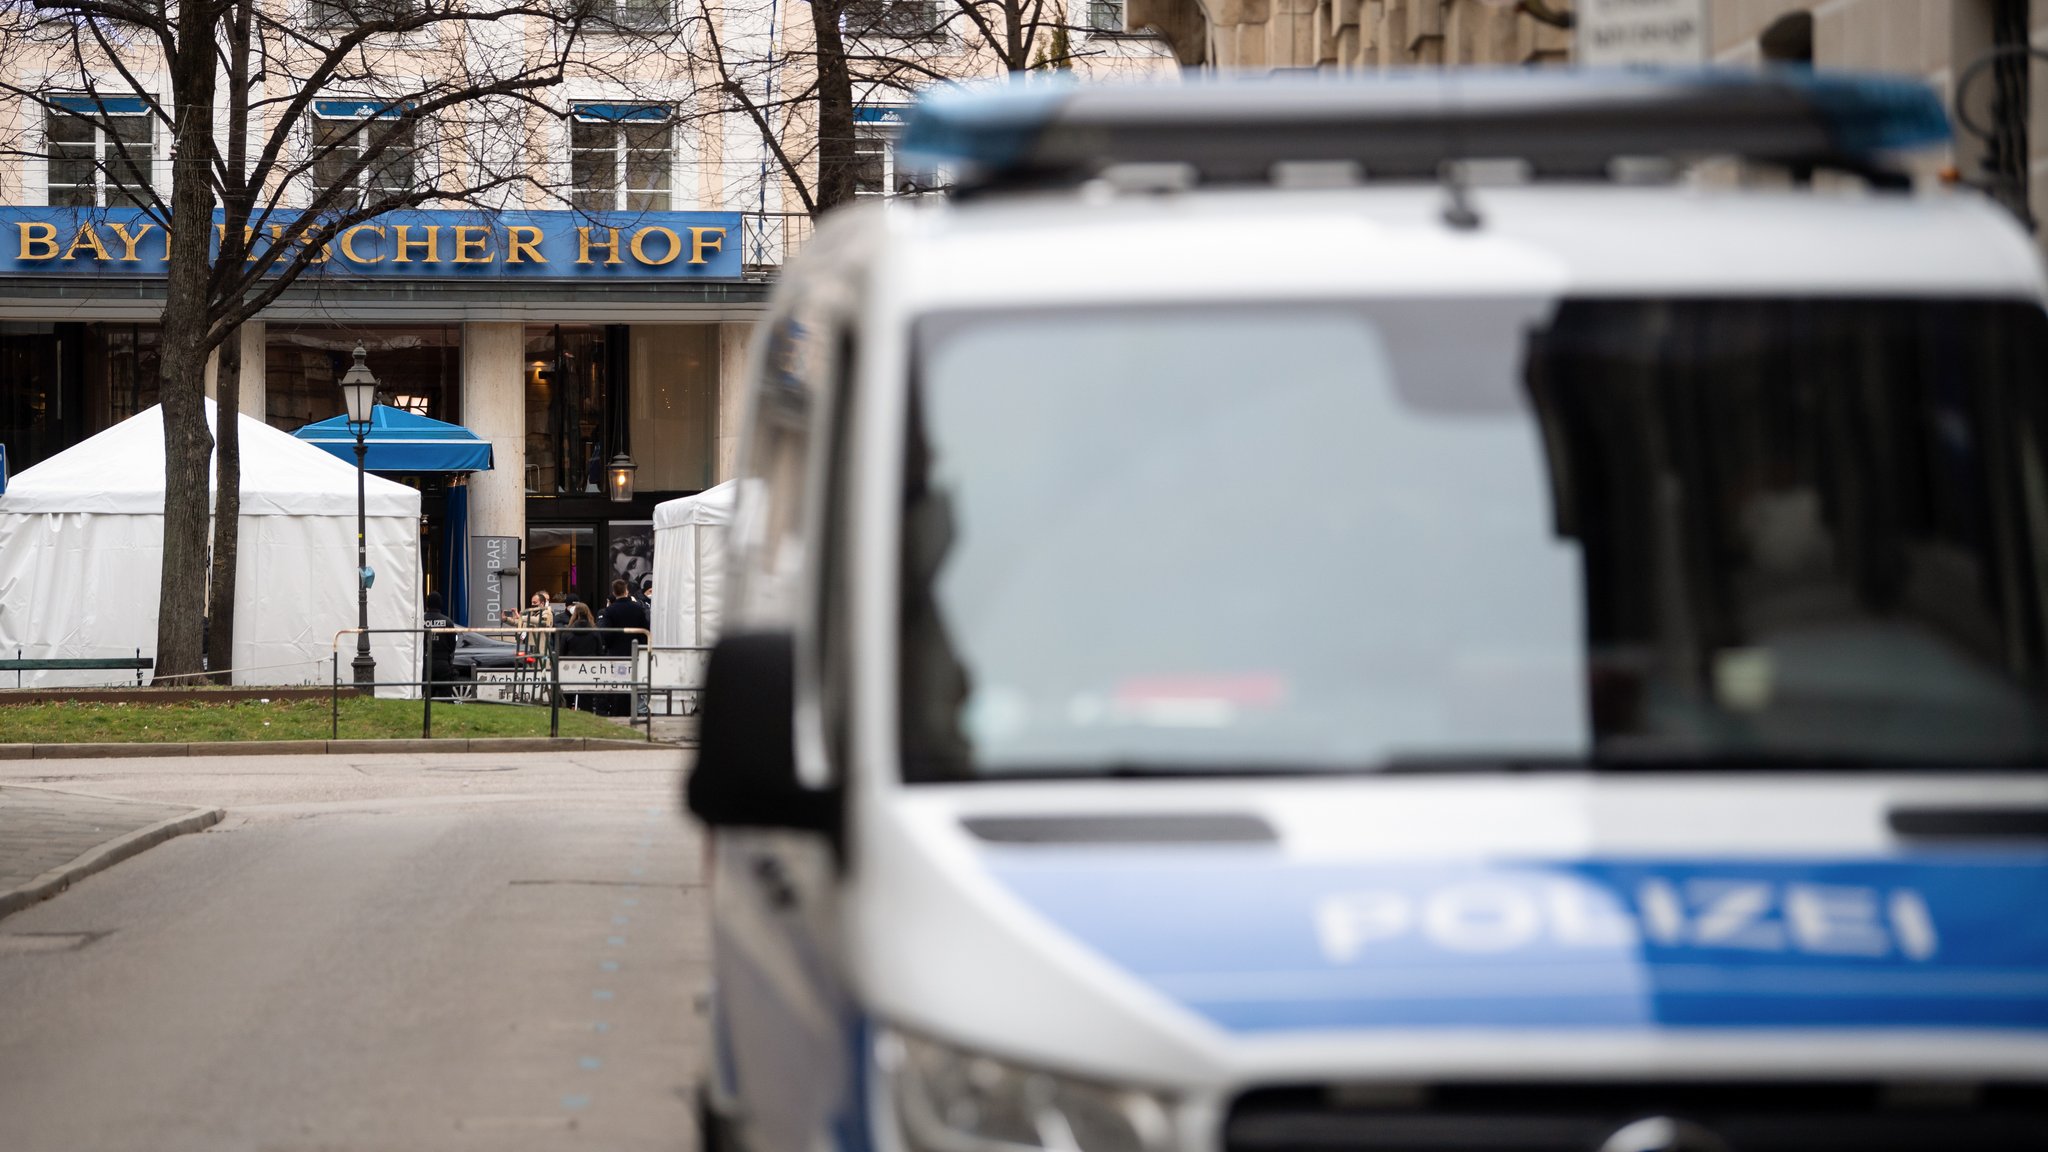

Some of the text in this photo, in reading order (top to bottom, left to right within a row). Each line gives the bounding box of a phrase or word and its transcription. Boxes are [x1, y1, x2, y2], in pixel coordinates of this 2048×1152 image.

[573, 225, 727, 266] HOF
[487, 539, 501, 622] POLAR BAR
[1314, 872, 1937, 964] POLIZEI
